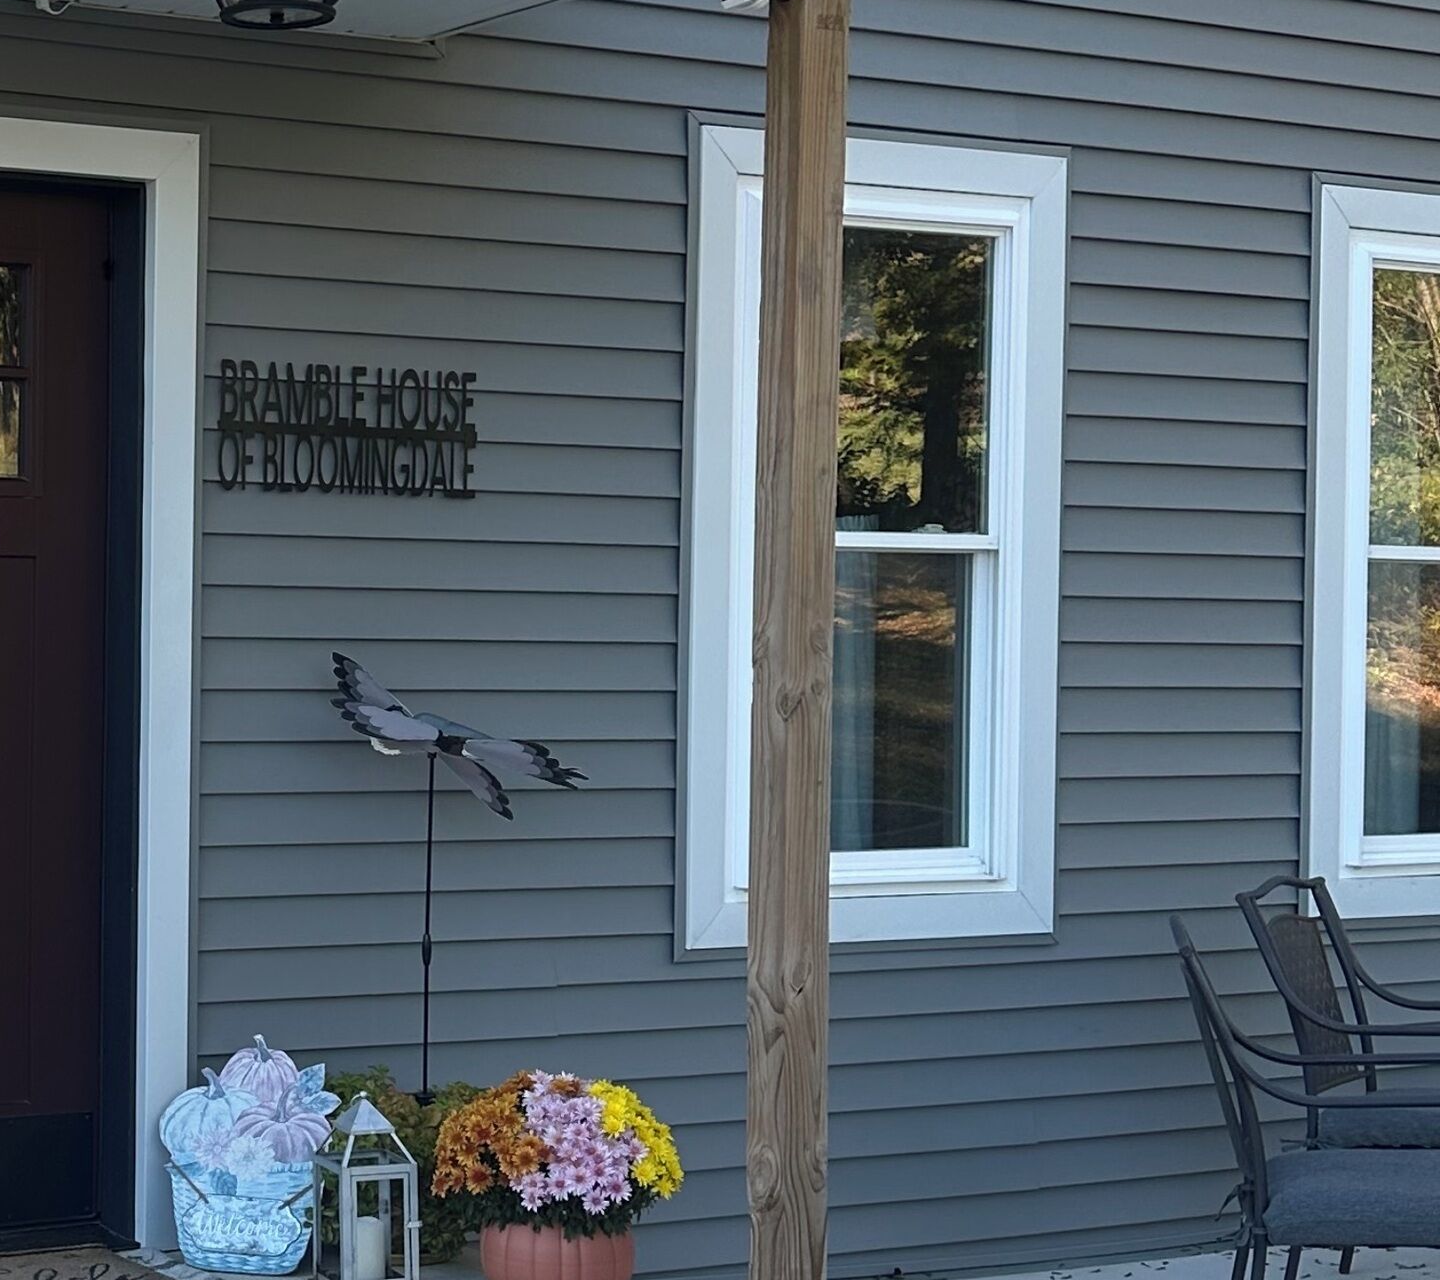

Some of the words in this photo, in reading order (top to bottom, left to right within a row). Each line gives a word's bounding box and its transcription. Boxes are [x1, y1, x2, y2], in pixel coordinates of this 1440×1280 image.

[219, 358, 367, 426] BRAMBLE
[376, 367, 477, 433] HOUSE
[218, 428, 257, 491] OF
[263, 430, 477, 499] BLOOMINGDALE
[197, 1209, 289, 1236] Welcome
